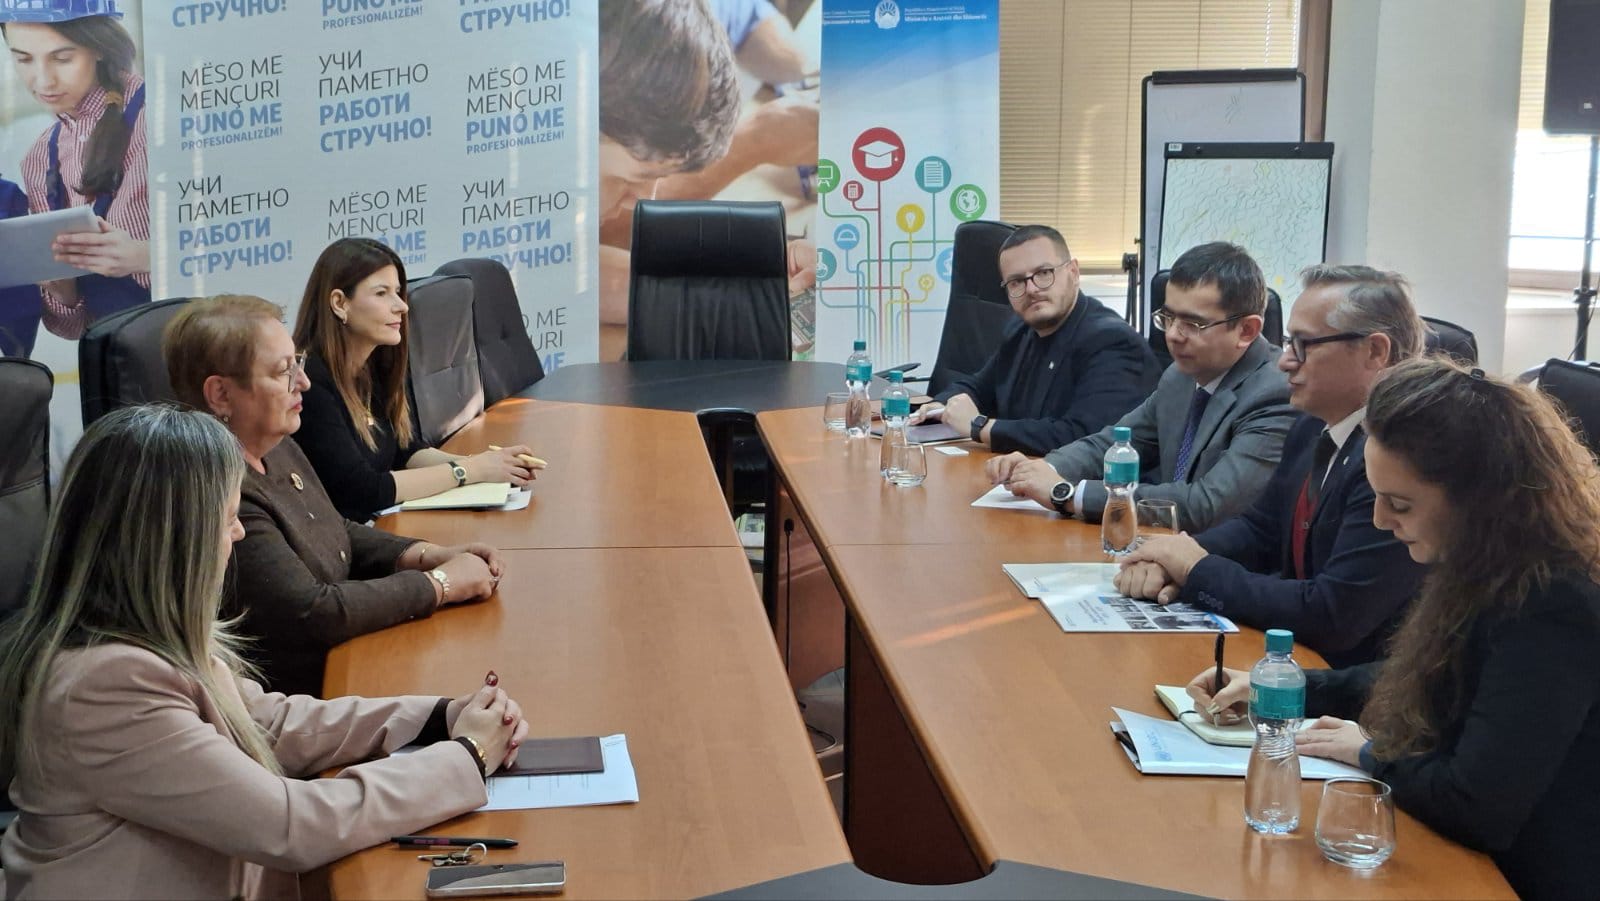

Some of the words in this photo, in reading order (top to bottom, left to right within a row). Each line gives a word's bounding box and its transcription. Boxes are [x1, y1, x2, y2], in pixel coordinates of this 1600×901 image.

[172, 0, 287, 28] СТРУЧНО!
[322, 6, 424, 30] PROFESIONALIZËM!
[460, 0, 571, 33] СТРУЧНО!
[181, 62, 244, 89] MËSO
[251, 55, 283, 78] ME
[318, 50, 362, 75] УЧИ
[468, 66, 528, 93] MËSO
[535, 60, 566, 81] ME
[180, 79, 280, 112] MENÇURI
[318, 63, 429, 98] ПАМЕТНО
[250, 103, 283, 127] ME
[319, 92, 411, 126] РАБОТИ
[466, 83, 562, 117] MENÇURI
[320, 116, 432, 153] СТРУЧНО!
[533, 107, 564, 129] ME
[181, 126, 283, 151] PROFESIONALIZËM!
[466, 130, 565, 155] PROFESIONALIZËM!
[178, 175, 222, 200] УЧИ
[329, 191, 390, 217] MËSO
[397, 184, 427, 206] ME
[463, 178, 504, 203] УЧИ
[178, 188, 289, 223] ПАМЕТНО
[462, 191, 570, 226] ПАМЕТНО
[179, 217, 271, 250] РАБОТИ
[328, 207, 424, 240] MENÇURI
[462, 219, 551, 252] РАБОТИ
[395, 230, 426, 252] ME
[179, 240, 293, 277] СТРУЧНО!
[537, 307, 567, 329] ME
